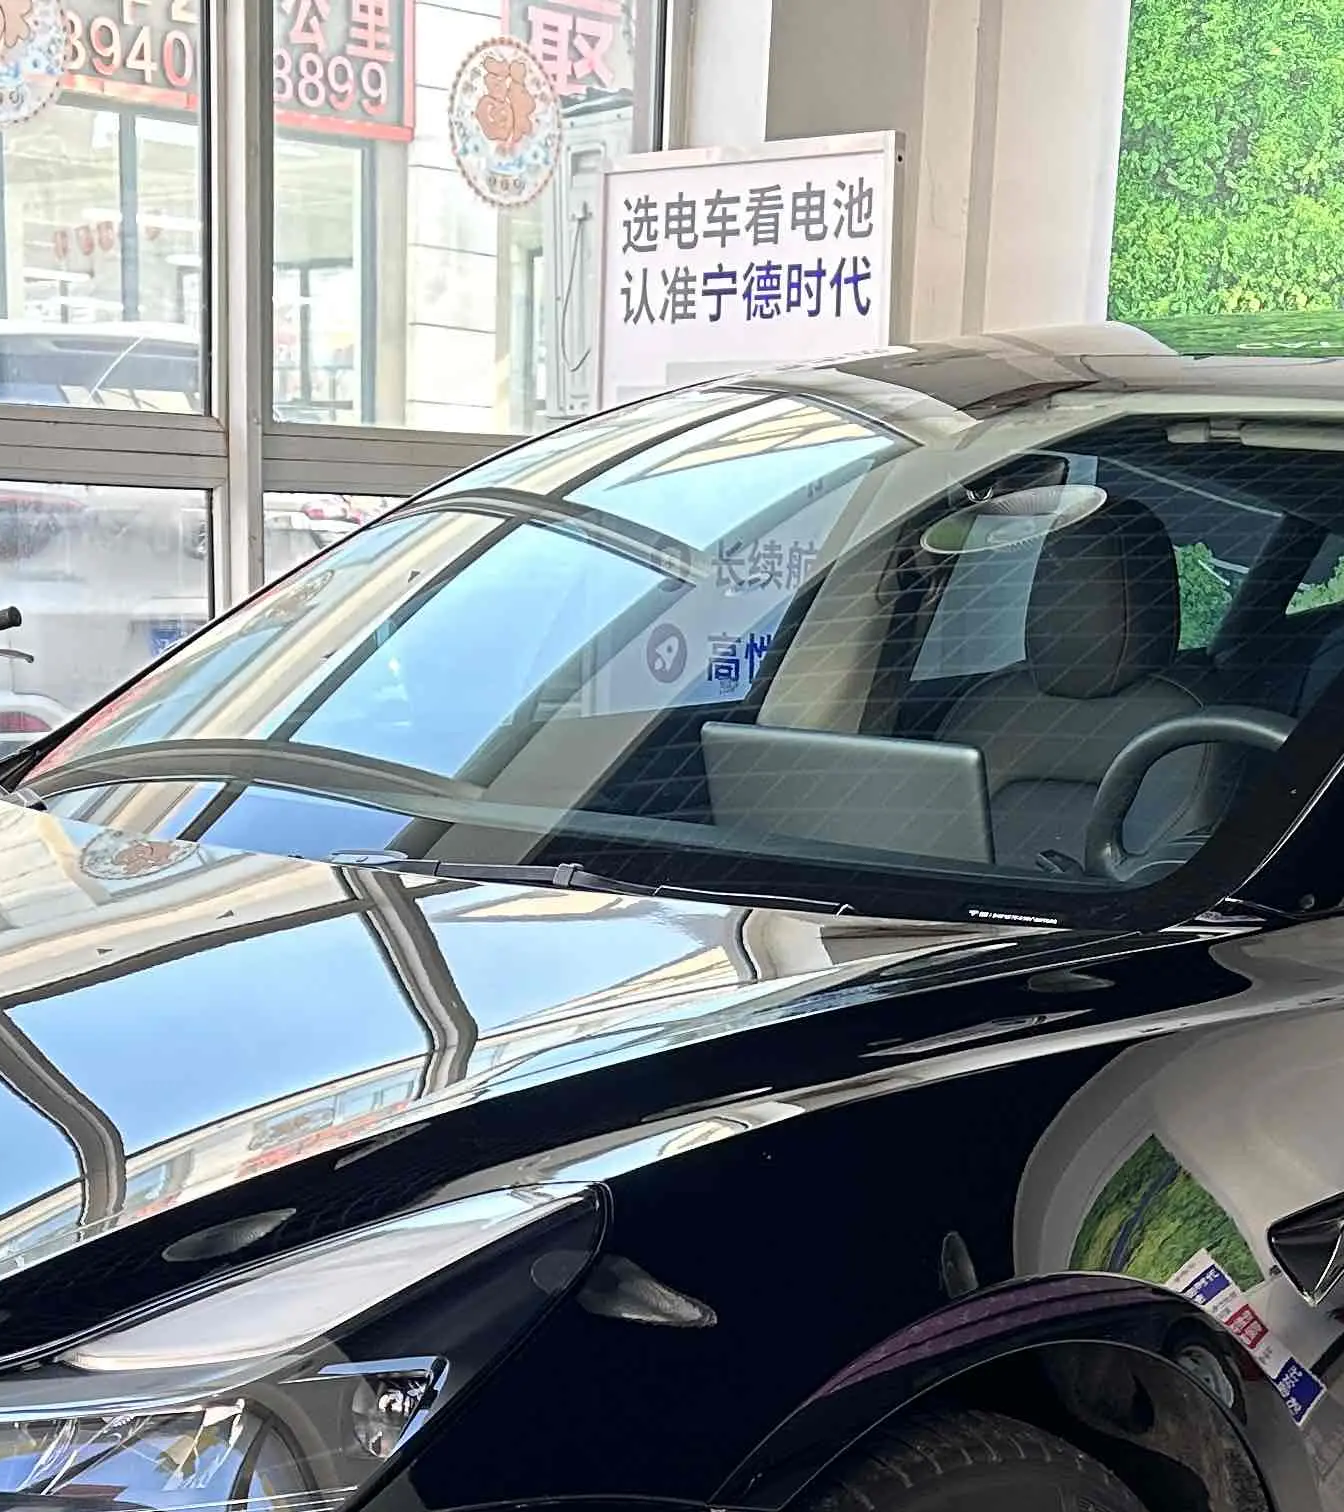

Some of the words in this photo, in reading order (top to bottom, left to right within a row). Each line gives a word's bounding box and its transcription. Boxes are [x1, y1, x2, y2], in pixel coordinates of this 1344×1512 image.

[273, 48, 388, 116] 8899
[622, 177, 874, 254] 选电车看电池
[620, 256, 872, 326] 认准宁德时代
